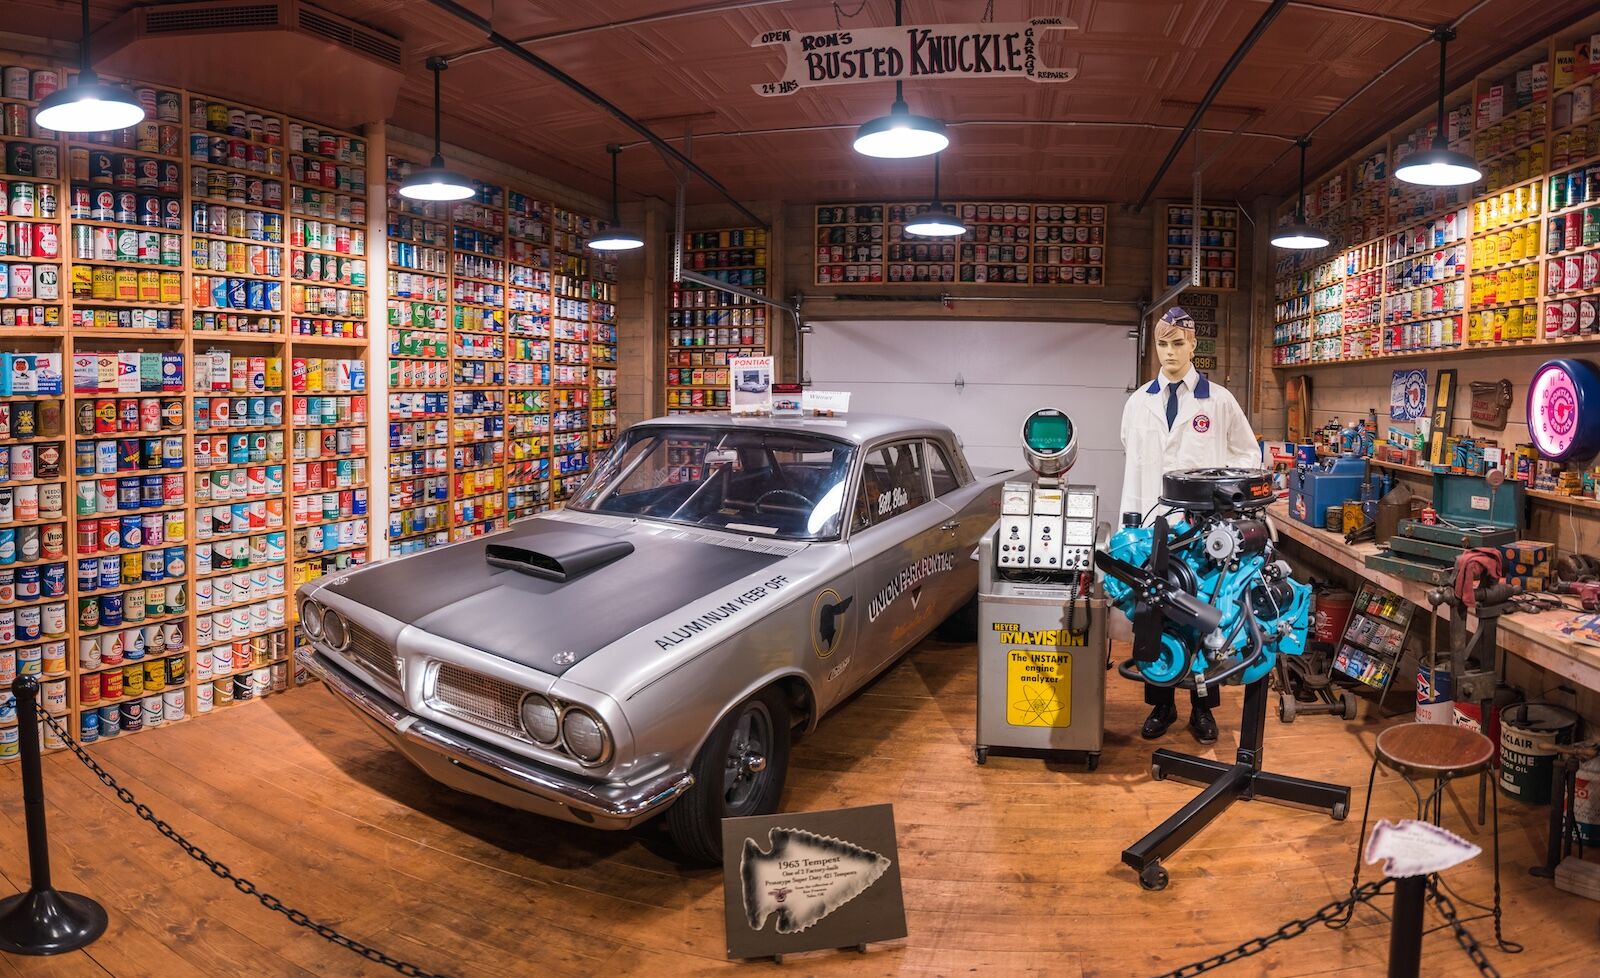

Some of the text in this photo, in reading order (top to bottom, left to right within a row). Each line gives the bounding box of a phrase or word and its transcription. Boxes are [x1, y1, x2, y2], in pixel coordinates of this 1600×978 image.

[761, 29, 791, 43] OPEN
[801, 32, 853, 51] RON'S
[805, 28, 1023, 81] BUSTED KNUCKLE
[1024, 28, 1037, 77] GARAGE
[1037, 71, 1069, 79] REPAIRS
[762, 80, 799, 94] 24 HRS
[1550, 389, 1573, 405] PONTIAC
[1541, 406, 1545, 416] 9
[1549, 436, 1554, 444] 7
[1559, 441, 1563, 450] 6
[878, 491, 892, 515] Bill
[868, 577, 900, 623] UNION
[899, 560, 924, 593] PARK
[922, 552, 955, 579] PONTIAC
[654, 575, 790, 651] ALUMINUM KEEP OFF
[994, 623, 1019, 631] HEYER
[1011, 653, 1068, 664] The INSTANT
[1025, 664, 1055, 673] engine
[1020, 674, 1059, 684] analyzer
[1515, 765, 1528, 774] OIL
[802, 856, 841, 867] Tempest
[765, 879, 791, 887] Prototype
